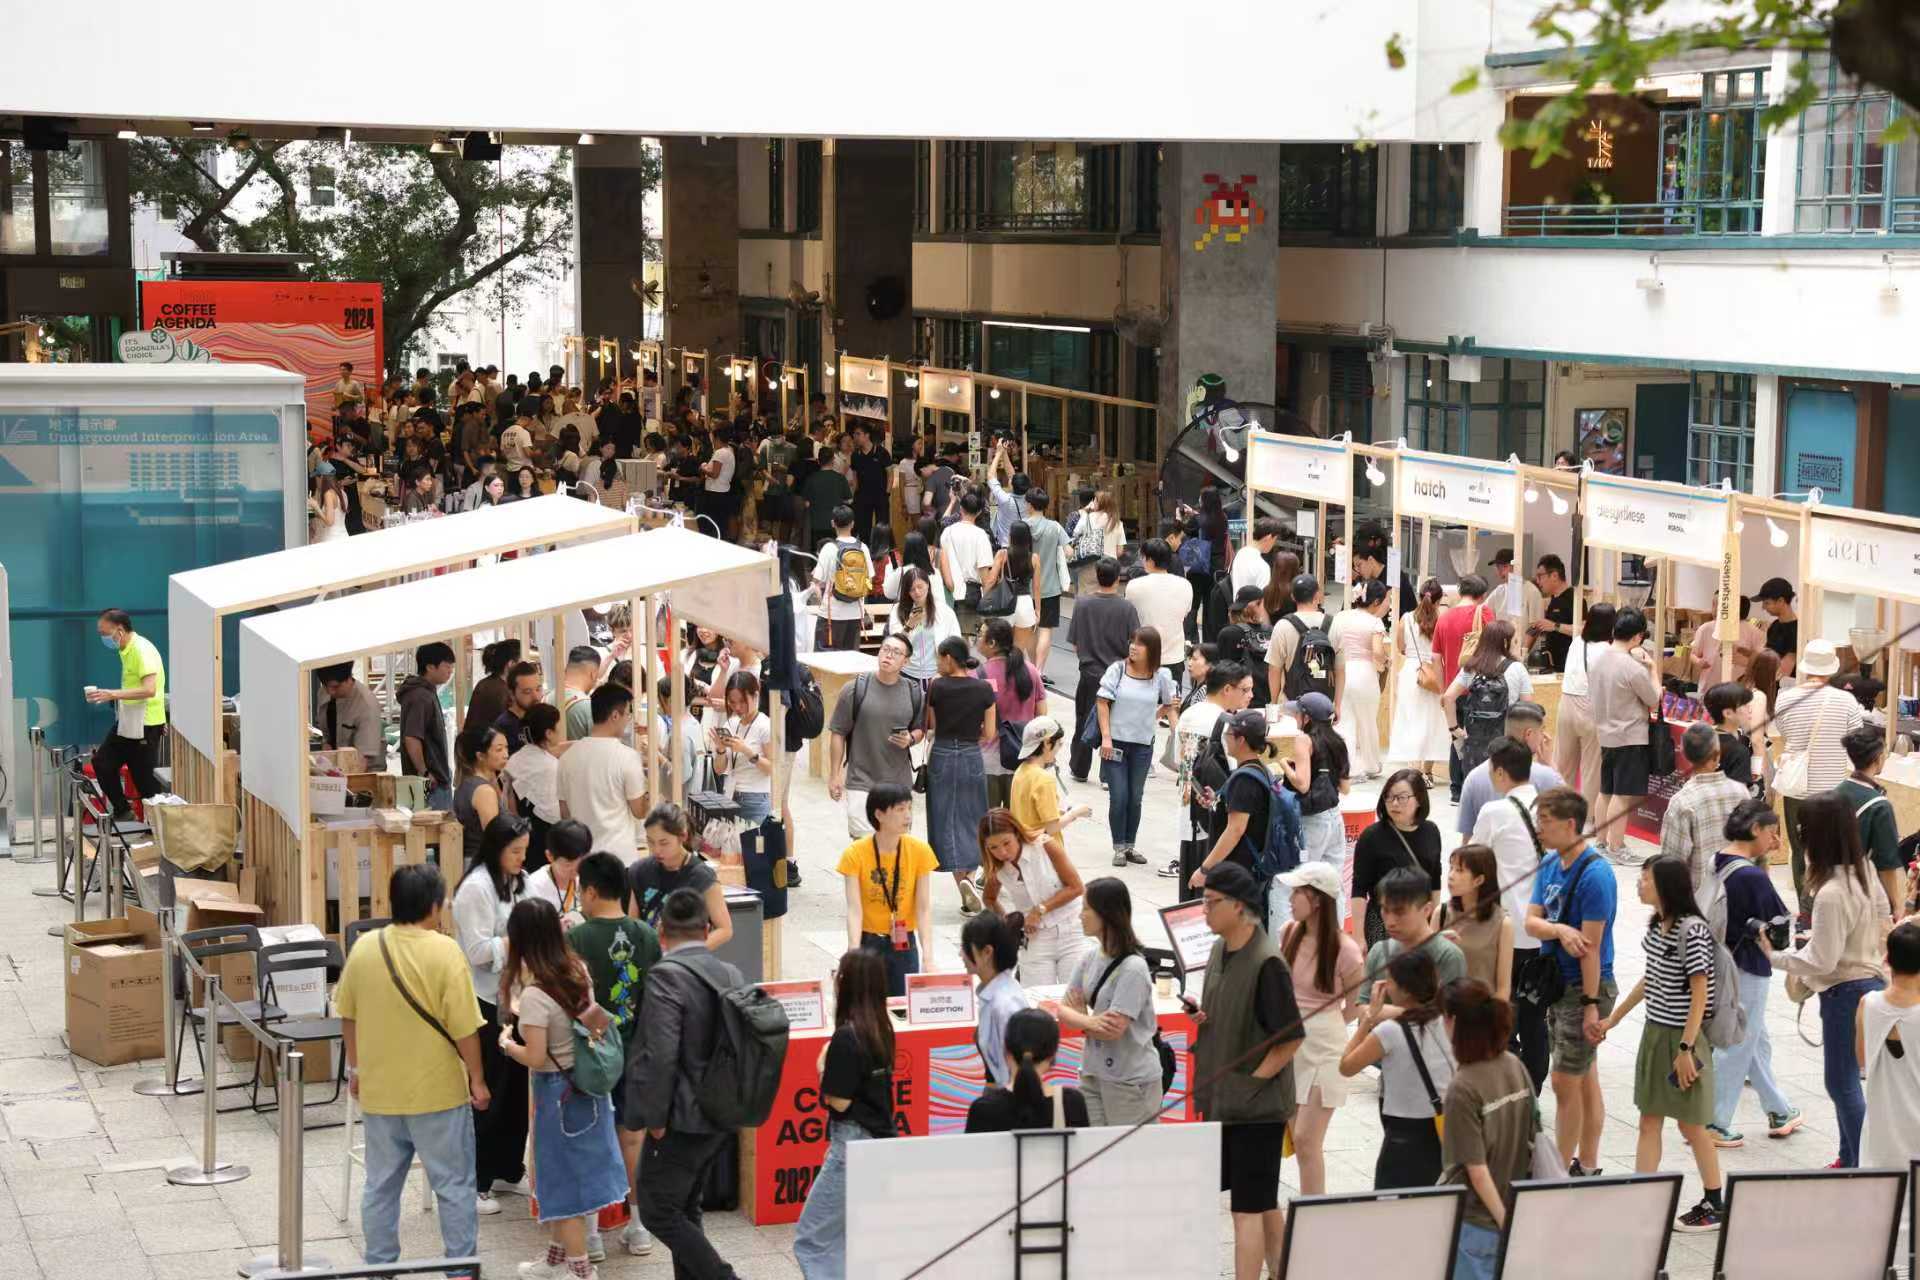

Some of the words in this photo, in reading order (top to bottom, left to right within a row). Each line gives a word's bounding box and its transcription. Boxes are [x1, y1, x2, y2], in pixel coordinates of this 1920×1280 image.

[161, 304, 217, 315] COFFEE
[153, 317, 217, 328] AGENDA
[344, 308, 375, 329] 2024
[49, 432, 139, 444] Underground
[239, 432, 268, 442] Area
[1414, 479, 1446, 500] hatch
[920, 1006, 964, 1014] RECEPTION
